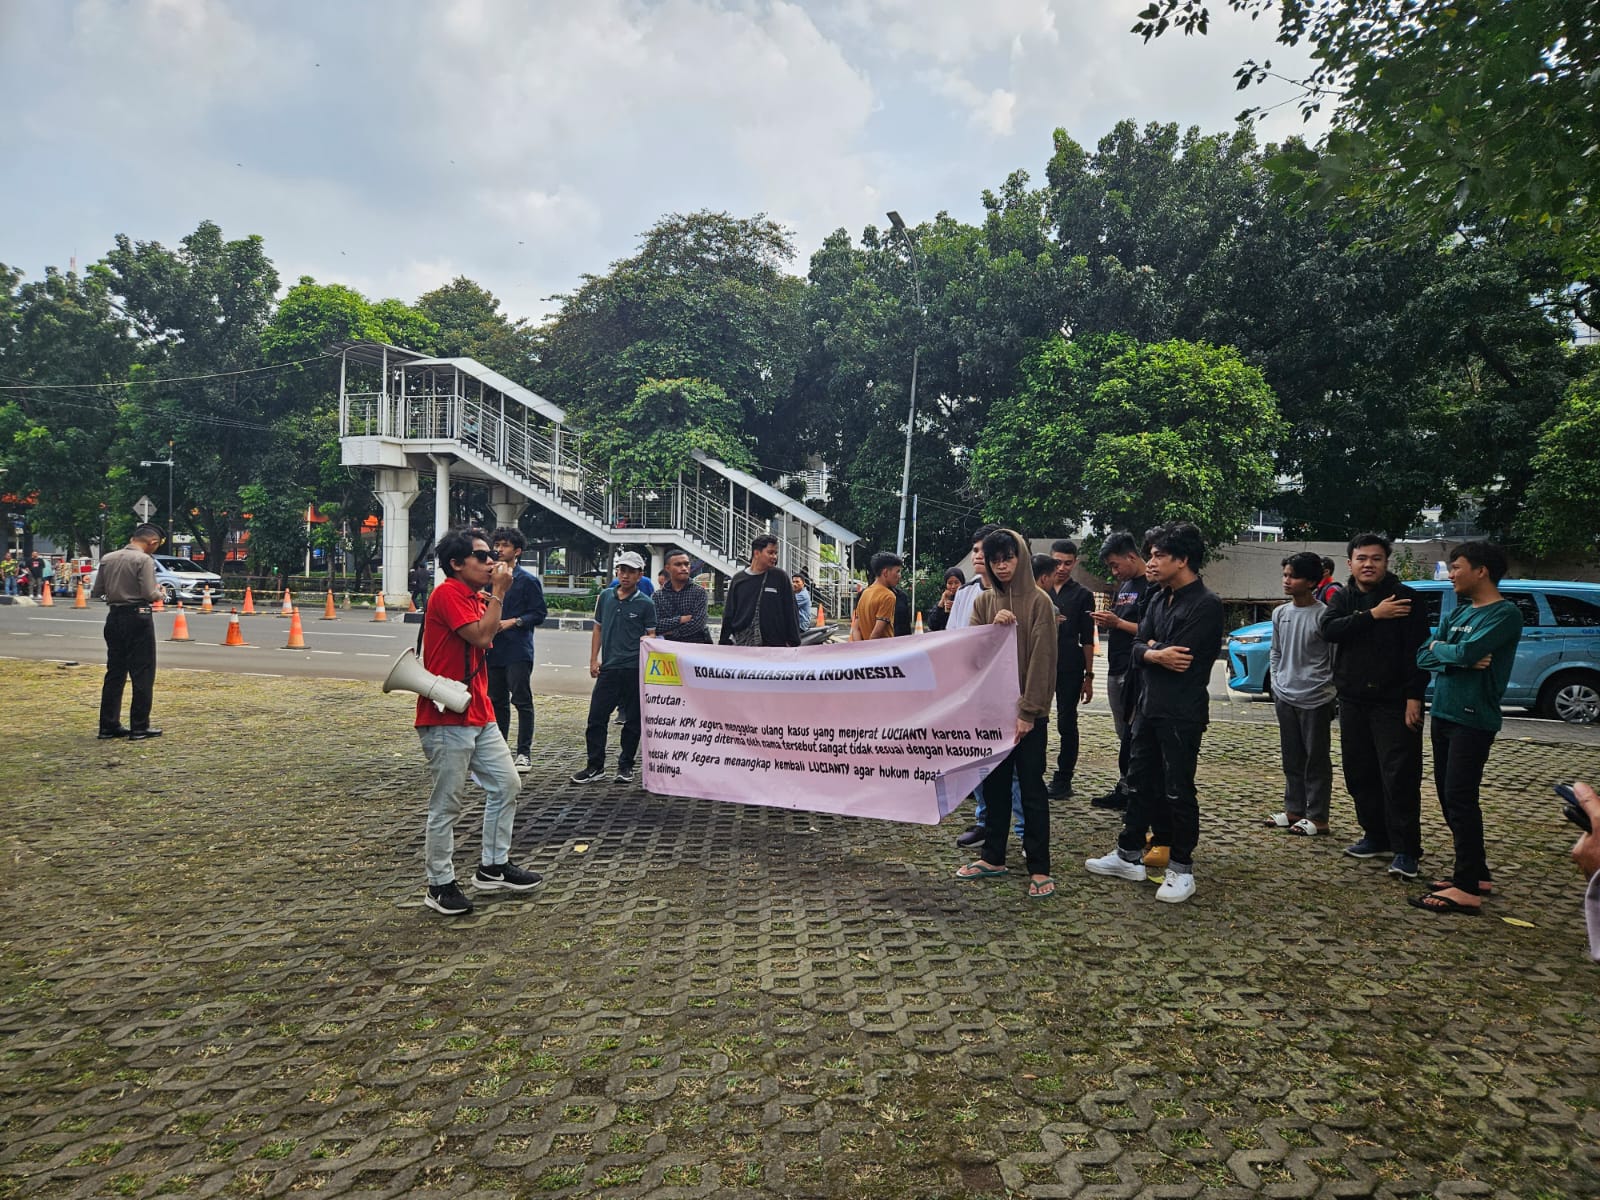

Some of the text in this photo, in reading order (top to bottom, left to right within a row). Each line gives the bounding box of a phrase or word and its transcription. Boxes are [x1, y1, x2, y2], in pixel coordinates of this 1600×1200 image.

[694, 665, 906, 681] KOALISI MAHASISWA INDONESIA
[680, 716, 697, 728] KPK
[699, 720, 723, 733] segera
[724, 723, 758, 736] menggelar
[761, 725, 784, 740] ulang
[787, 725, 810, 737] kasus
[813, 728, 835, 742] yang
[838, 727, 879, 743] menjerat
[881, 728, 927, 740] LUCIANTY
[931, 728, 971, 740] karena
[975, 727, 1003, 741] kami
[653, 729, 690, 741] hukuman
[691, 733, 713, 746] yang
[761, 740, 782, 749] nama
[782, 740, 817, 753] tersebut
[818, 742, 848, 757] sangat
[850, 742, 873, 755] tidak
[874, 744, 905, 755] sesuai
[906, 743, 944, 760] dengan
[945, 745, 993, 759] kasusnya
[671, 750, 690, 761] KPK
[691, 752, 720, 767] Segera
[724, 757, 772, 772] menangkap
[774, 759, 805, 772] kembali
[808, 762, 850, 775] LUCIANTY
[853, 765, 876, 780] agar
[879, 766, 910, 779] hukum
